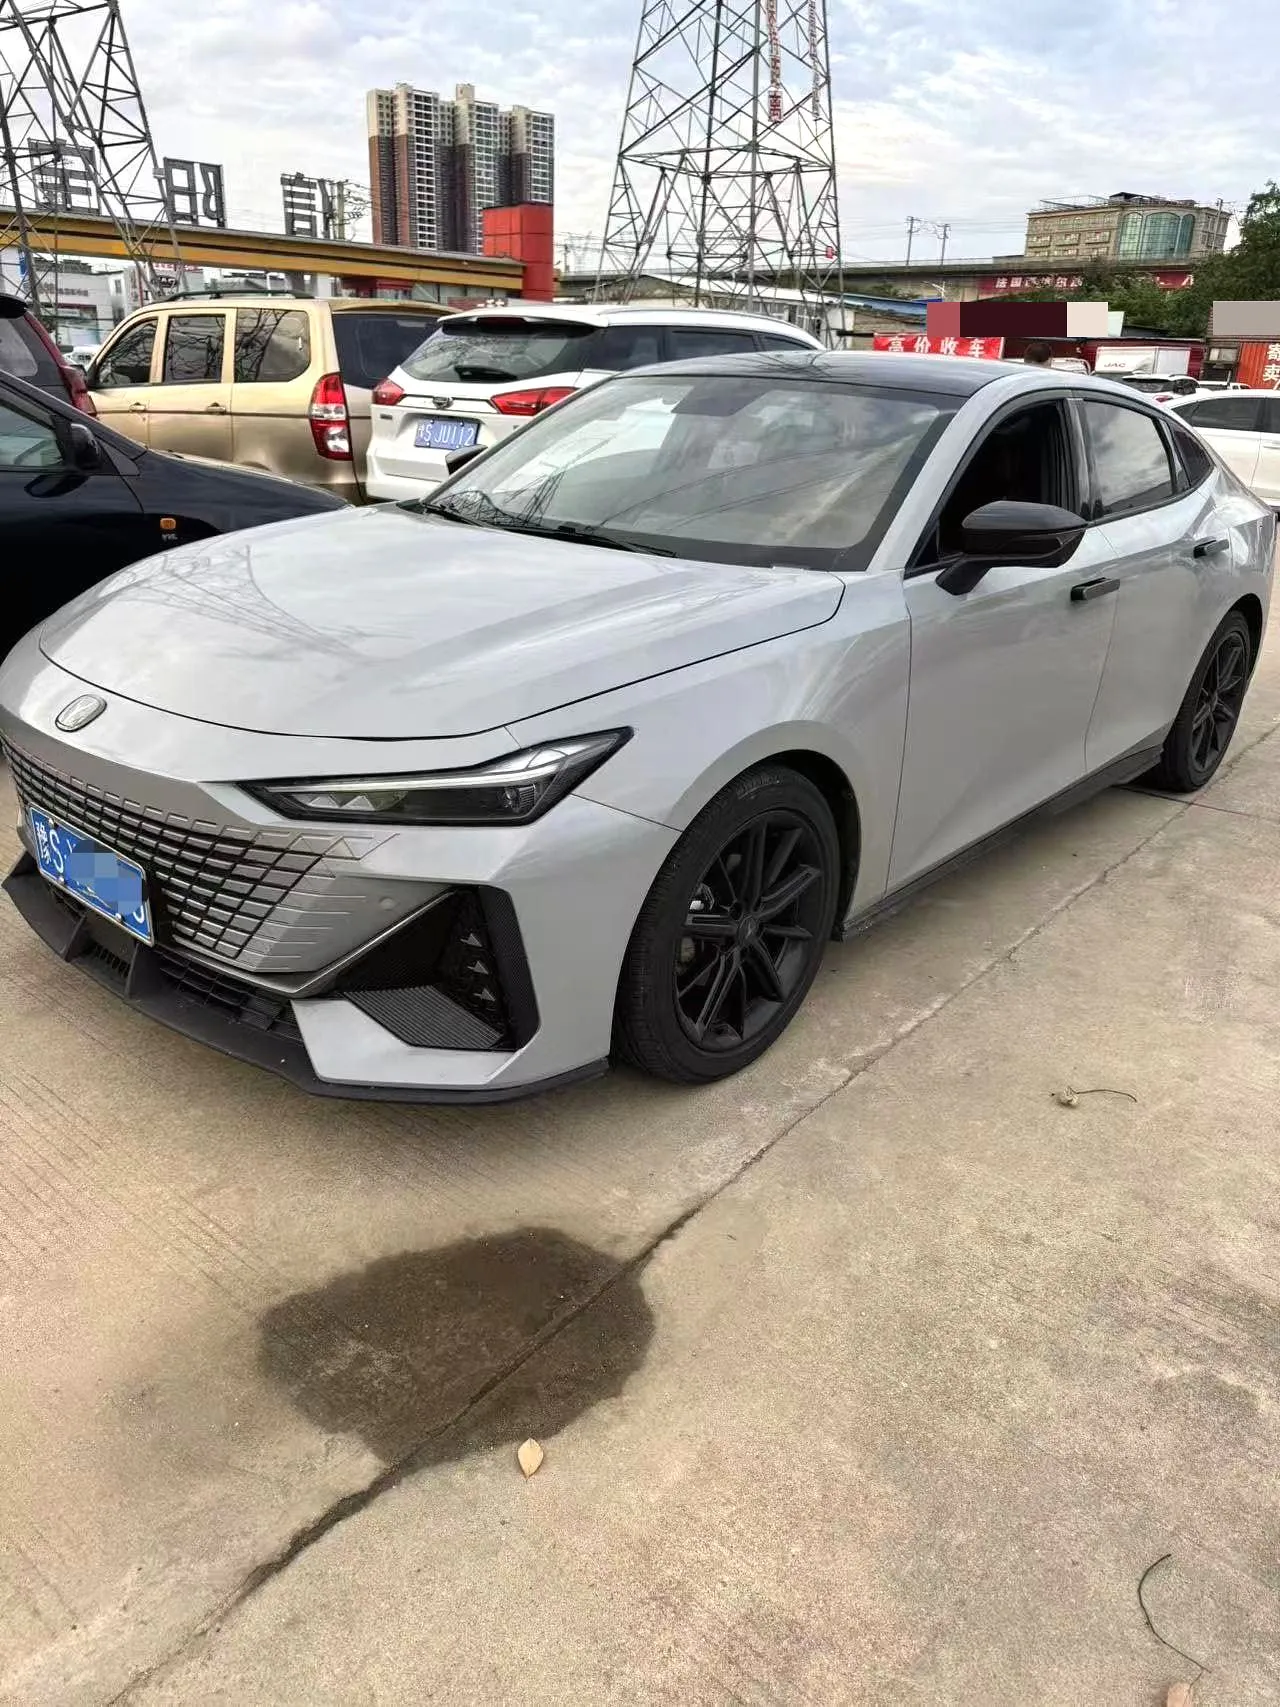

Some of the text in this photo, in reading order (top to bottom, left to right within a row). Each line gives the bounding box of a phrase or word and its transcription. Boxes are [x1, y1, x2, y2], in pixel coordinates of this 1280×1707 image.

[888, 335, 985, 358] 高价收车
[1103, 361, 1126, 369] JAC
